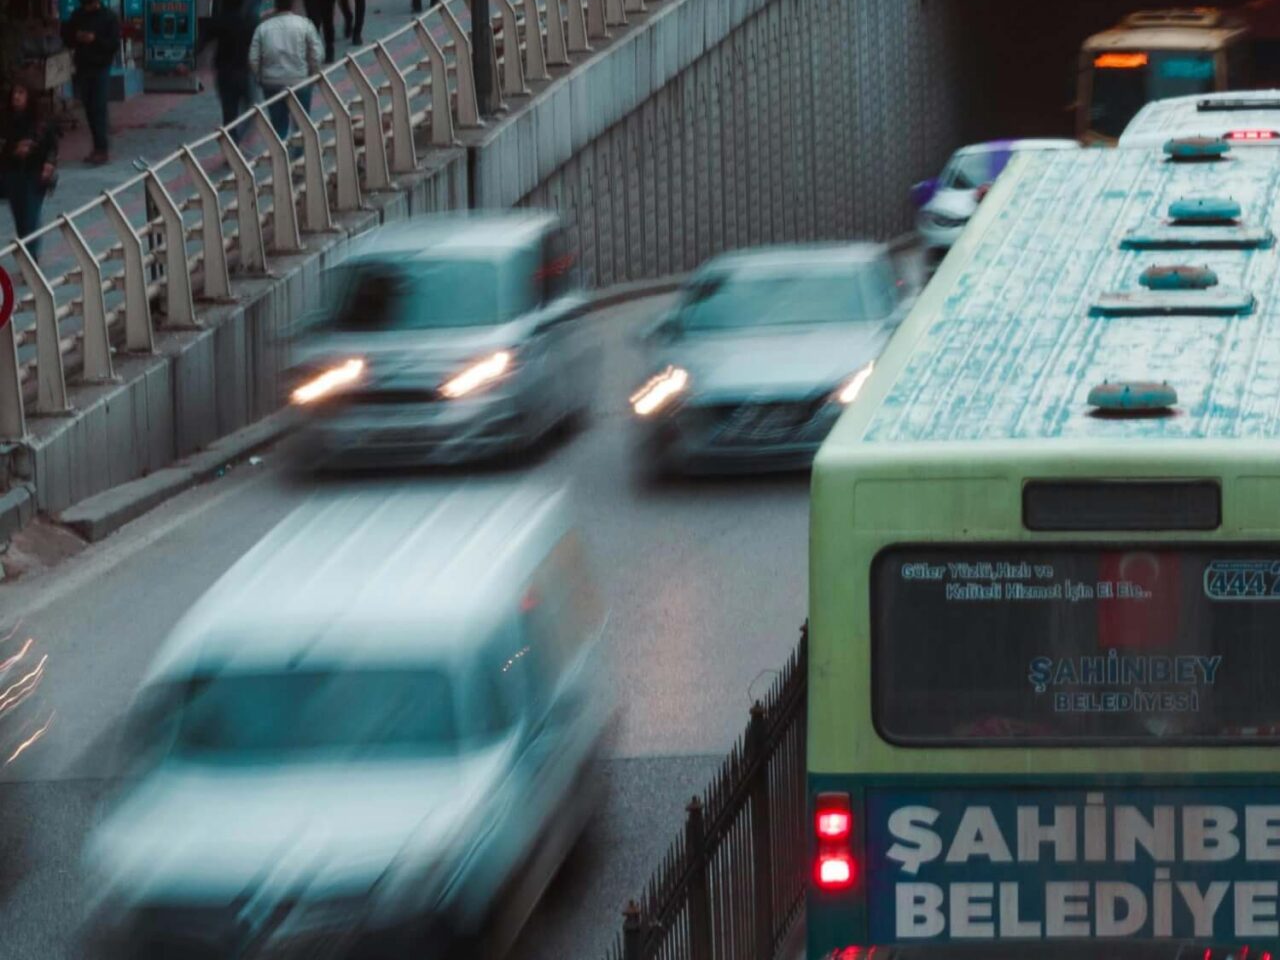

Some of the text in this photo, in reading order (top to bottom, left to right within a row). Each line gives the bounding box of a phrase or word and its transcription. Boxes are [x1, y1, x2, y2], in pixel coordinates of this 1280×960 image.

[902, 562, 945, 579] Güler
[1034, 565, 1054, 578] ve
[946, 582, 1002, 599] Kaliteli
[1005, 582, 1062, 599] Hizmet
[1065, 579, 1094, 602] İçin
[1096, 582, 1114, 599] El
[1209, 570, 1267, 596] 444
[1028, 648, 1222, 693] ŞAHİNBEY
[1054, 688, 1200, 712] BELEDİYESİ
